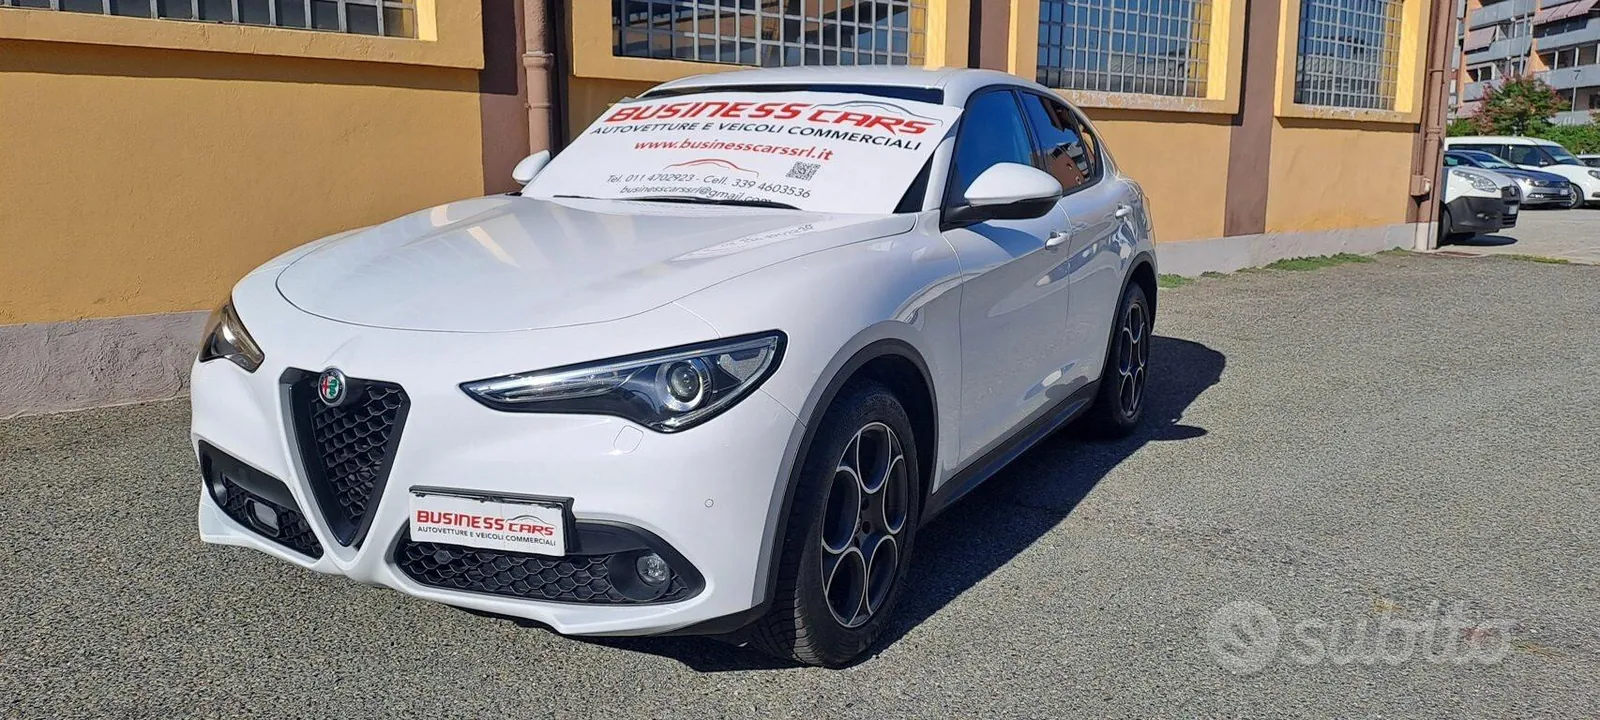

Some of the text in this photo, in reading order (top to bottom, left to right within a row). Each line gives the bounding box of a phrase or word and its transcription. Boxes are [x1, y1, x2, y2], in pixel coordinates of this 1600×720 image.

[604, 102, 936, 135] BUSINESS CARS
[590, 122, 921, 150] AUTOVETTURE E VEICOLI COMMERCIALI
[634, 138, 833, 161] www.businesscarssrl.it
[607, 174, 622, 183] Tel.
[625, 174, 646, 182] 011
[647, 173, 695, 182] 4702923
[703, 175, 729, 186] Cell.
[731, 178, 756, 189] 339
[757, 182, 811, 199] 4603536
[416, 510, 555, 536] BUSINESS CARS
[417, 526, 468, 537] AUTOVETTURE
[475, 532, 504, 540] VEICOLI
[505, 535, 556, 546] COMMERCIALI
